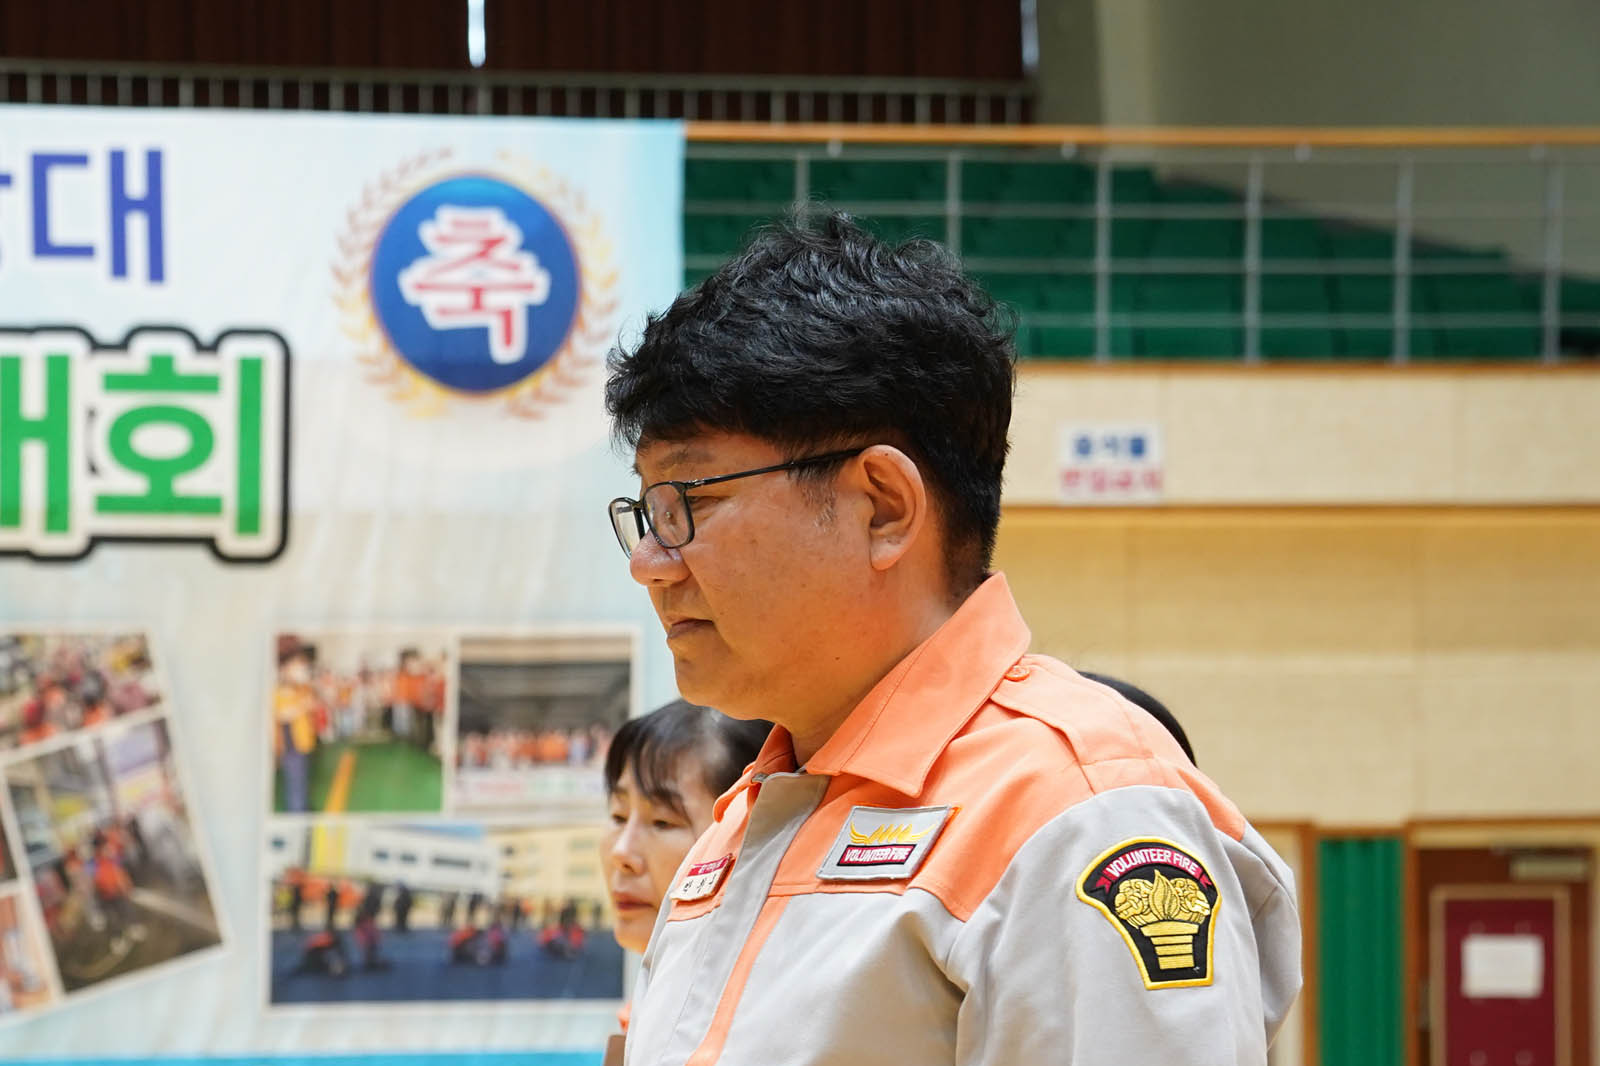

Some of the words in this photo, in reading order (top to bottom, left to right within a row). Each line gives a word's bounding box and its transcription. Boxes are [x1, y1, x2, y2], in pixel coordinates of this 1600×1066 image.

[414, 214, 539, 349] 축
[843, 847, 892, 862] VOLUNTEER
[888, 847, 913, 861] FIRE
[1106, 848, 1172, 878] VOLUNTEER
[1172, 854, 1200, 876] FIRE
